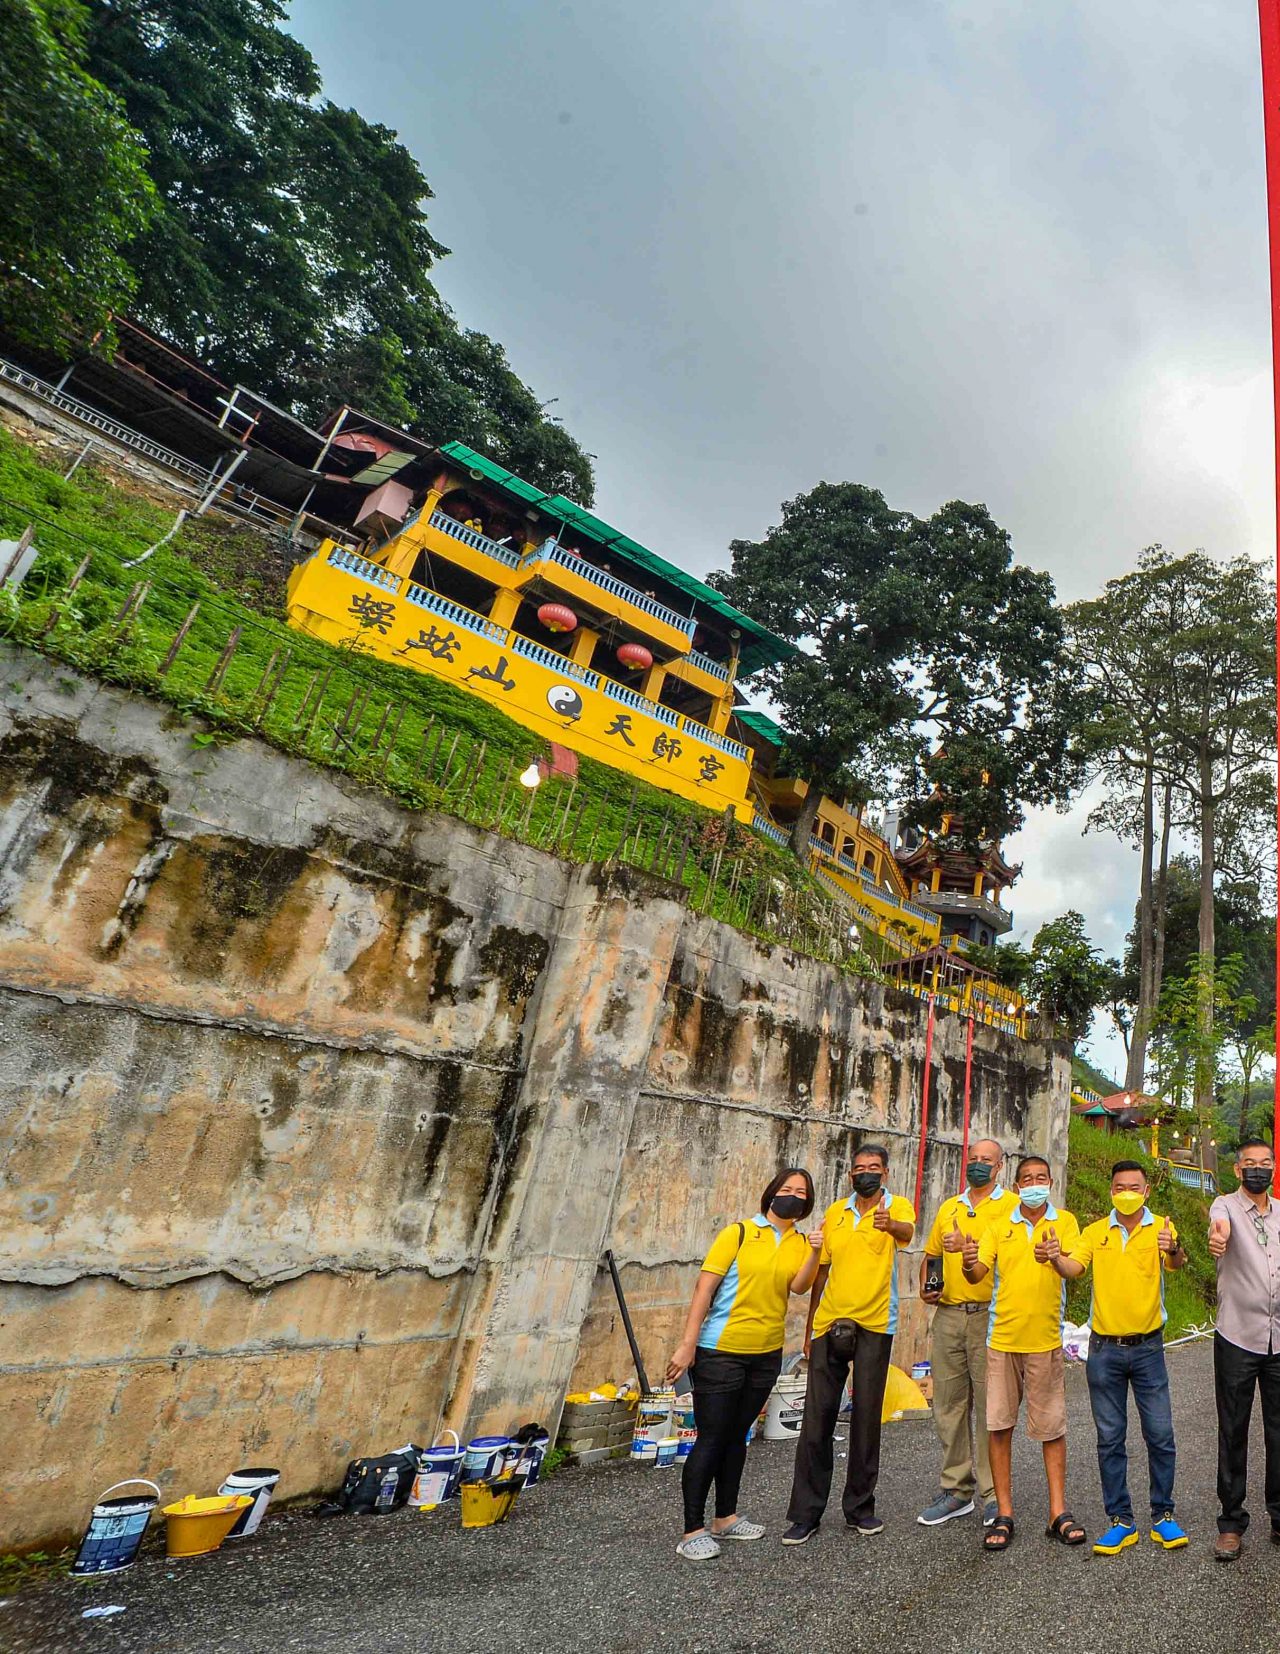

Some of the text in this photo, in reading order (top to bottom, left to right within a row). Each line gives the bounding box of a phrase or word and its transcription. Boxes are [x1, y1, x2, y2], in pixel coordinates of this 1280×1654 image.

[348, 591, 726, 782] 蜈蚣山 天師宮
